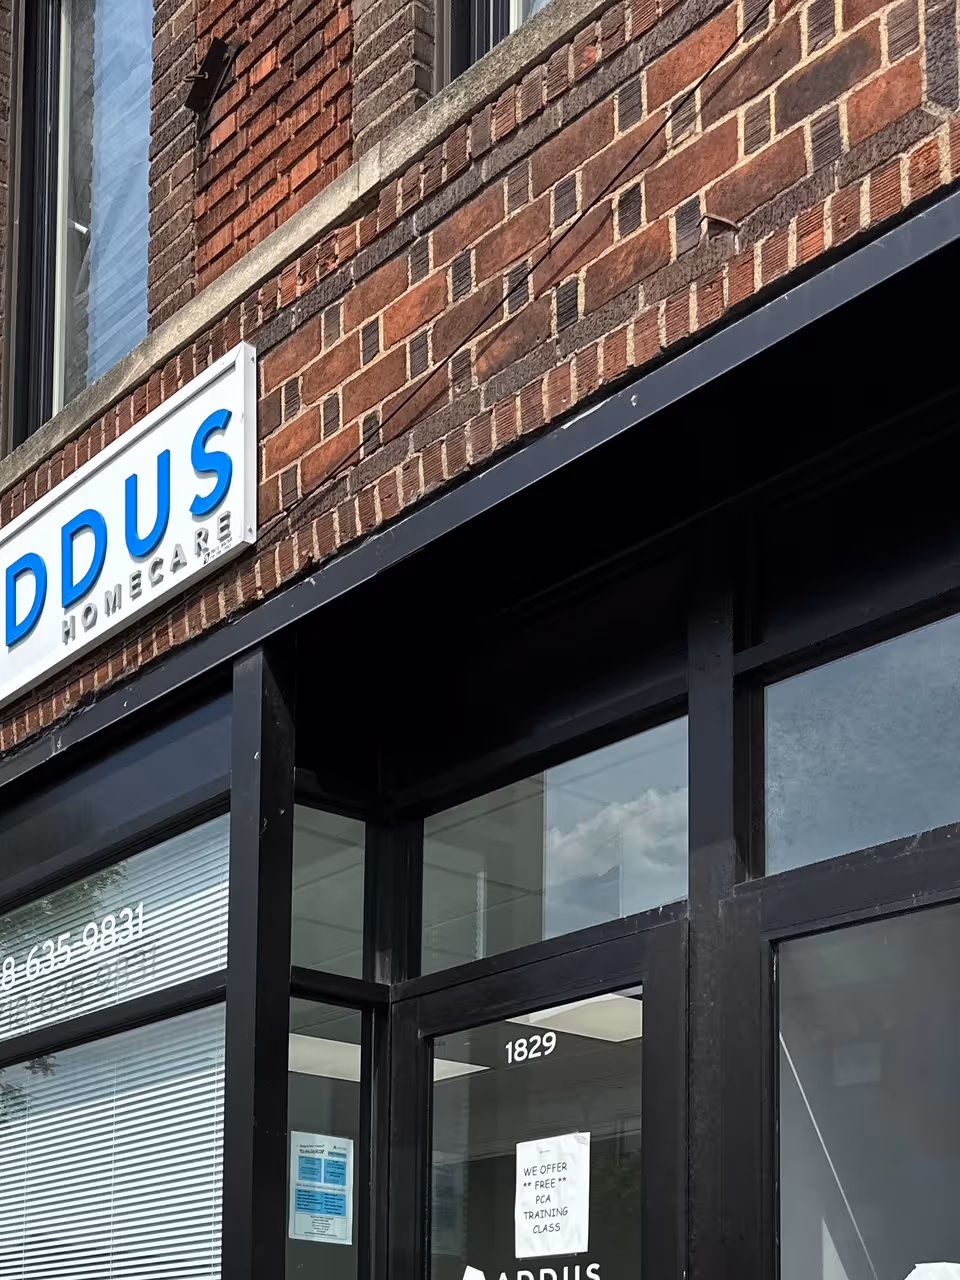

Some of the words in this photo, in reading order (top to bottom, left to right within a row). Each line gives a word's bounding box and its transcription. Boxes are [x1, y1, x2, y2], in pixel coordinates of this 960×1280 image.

[61, 510, 232, 646] HOMECARE
[505, 1031, 557, 1064] 1829
[523, 1166, 538, 1177] WE
[540, 1162, 568, 1175] OFFER
[535, 1178, 556, 1190] FREE
[536, 1195, 551, 1204] PCA
[524, 1207, 569, 1220] TRAINING
[533, 1223, 561, 1234] CLASS
